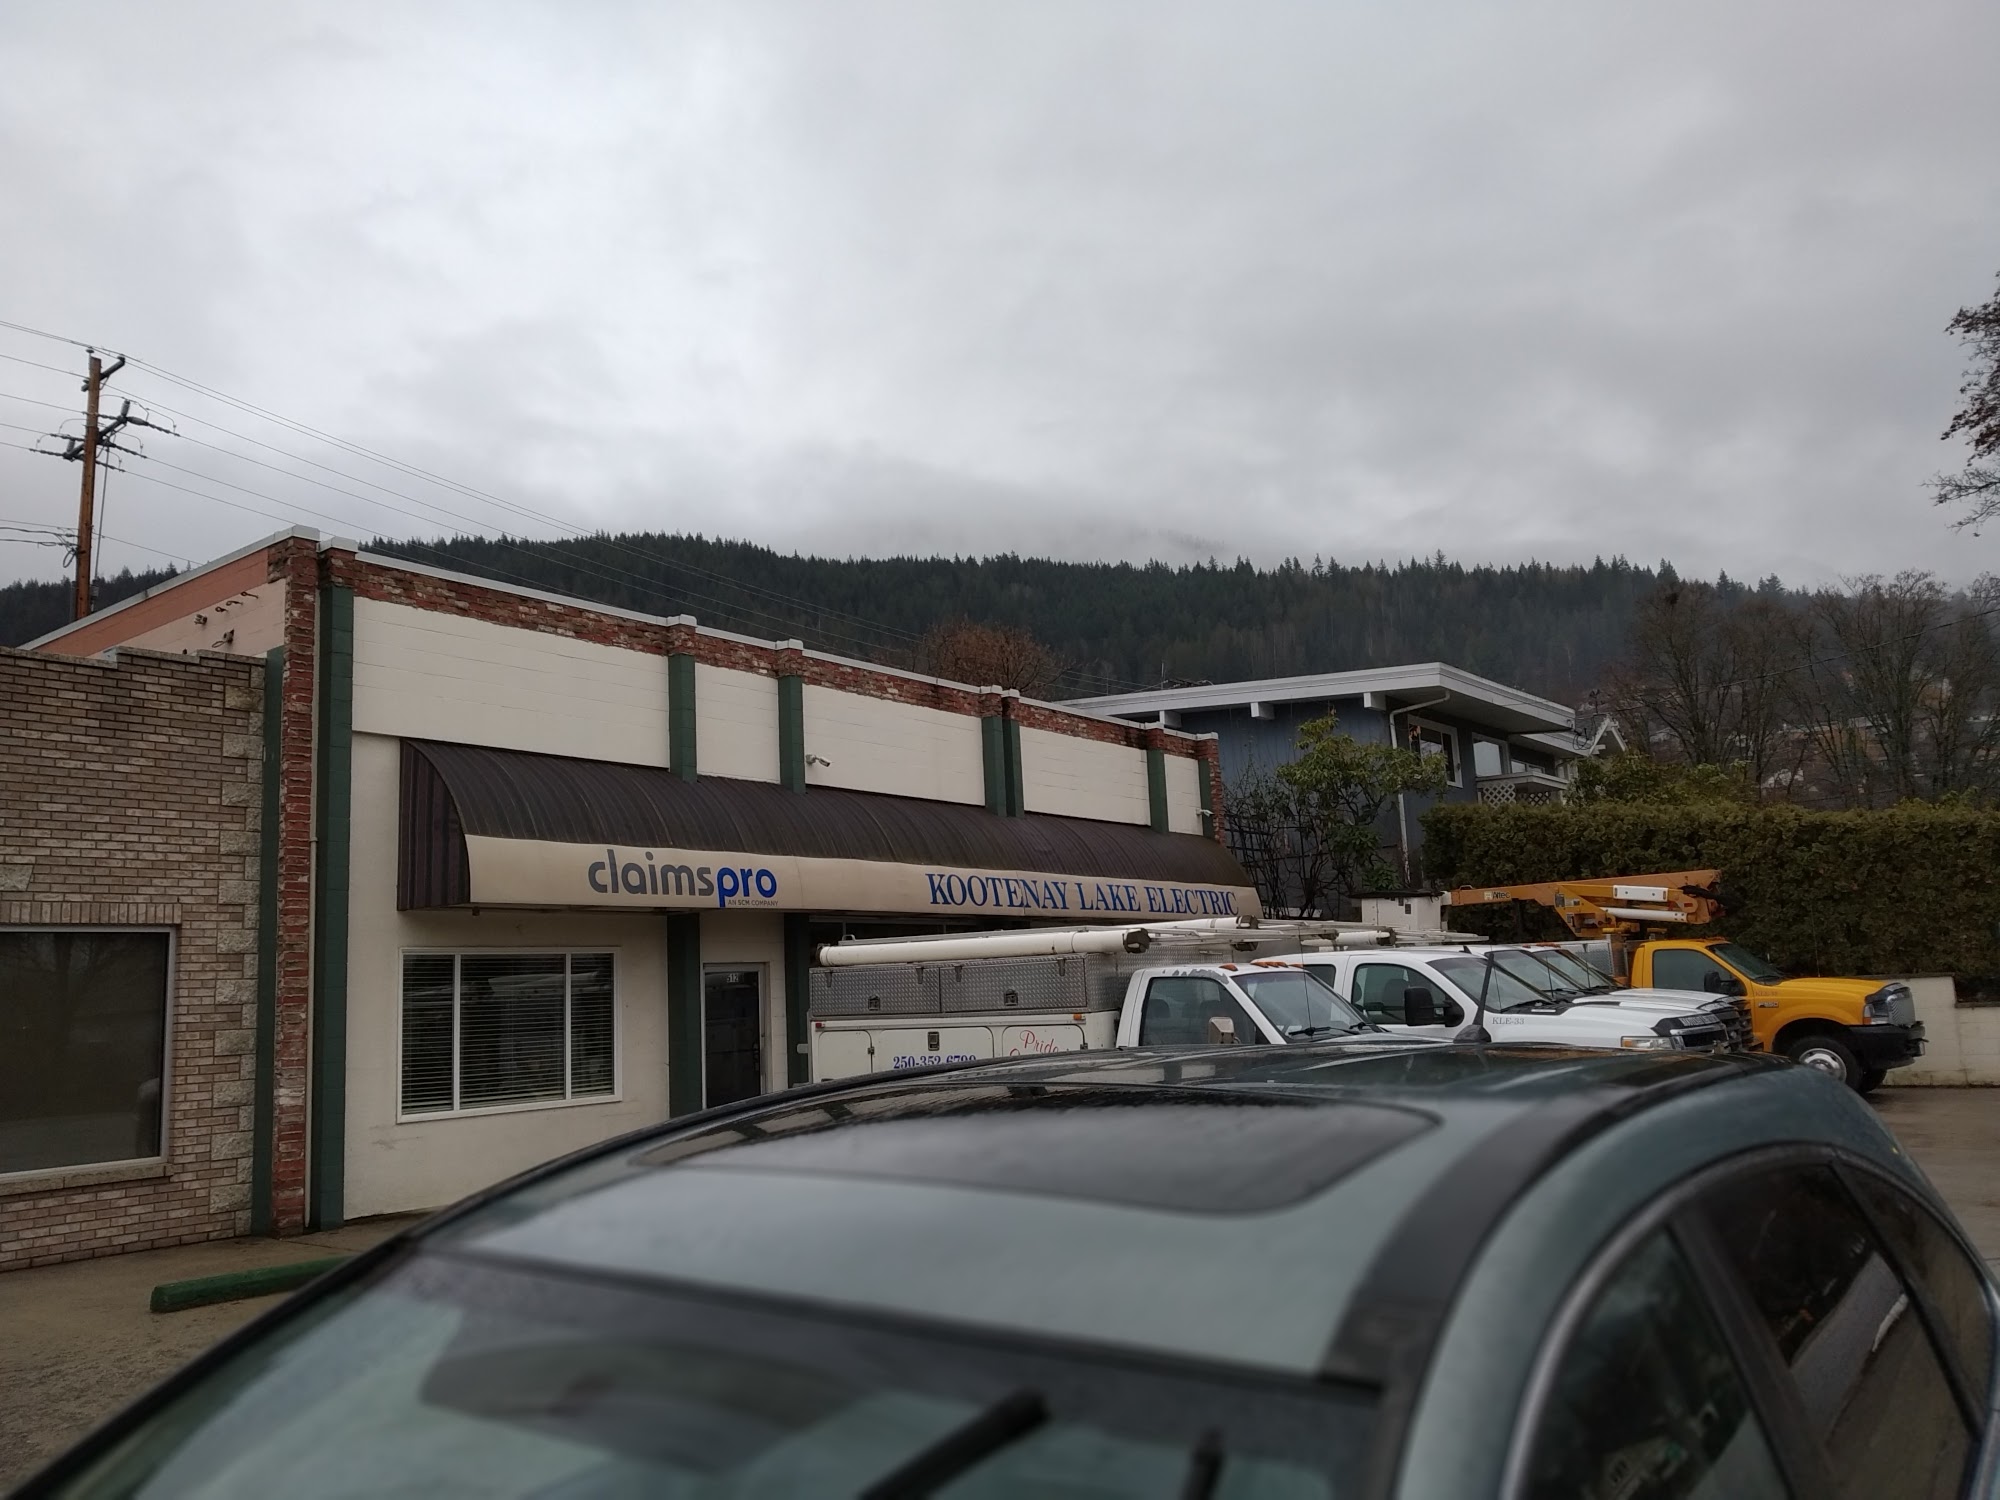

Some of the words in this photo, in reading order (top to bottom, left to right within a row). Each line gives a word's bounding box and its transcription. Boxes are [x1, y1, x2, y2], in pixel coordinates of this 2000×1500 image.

[588, 848, 778, 908] claimspro
[751, 899, 778, 907] COMPANY
[924, 873, 1070, 910] KOOTENAY
[1074, 882, 1142, 913] LAKE
[1143, 885, 1240, 917] ELECTRIC
[1491, 1017, 1525, 1025] KLE-33
